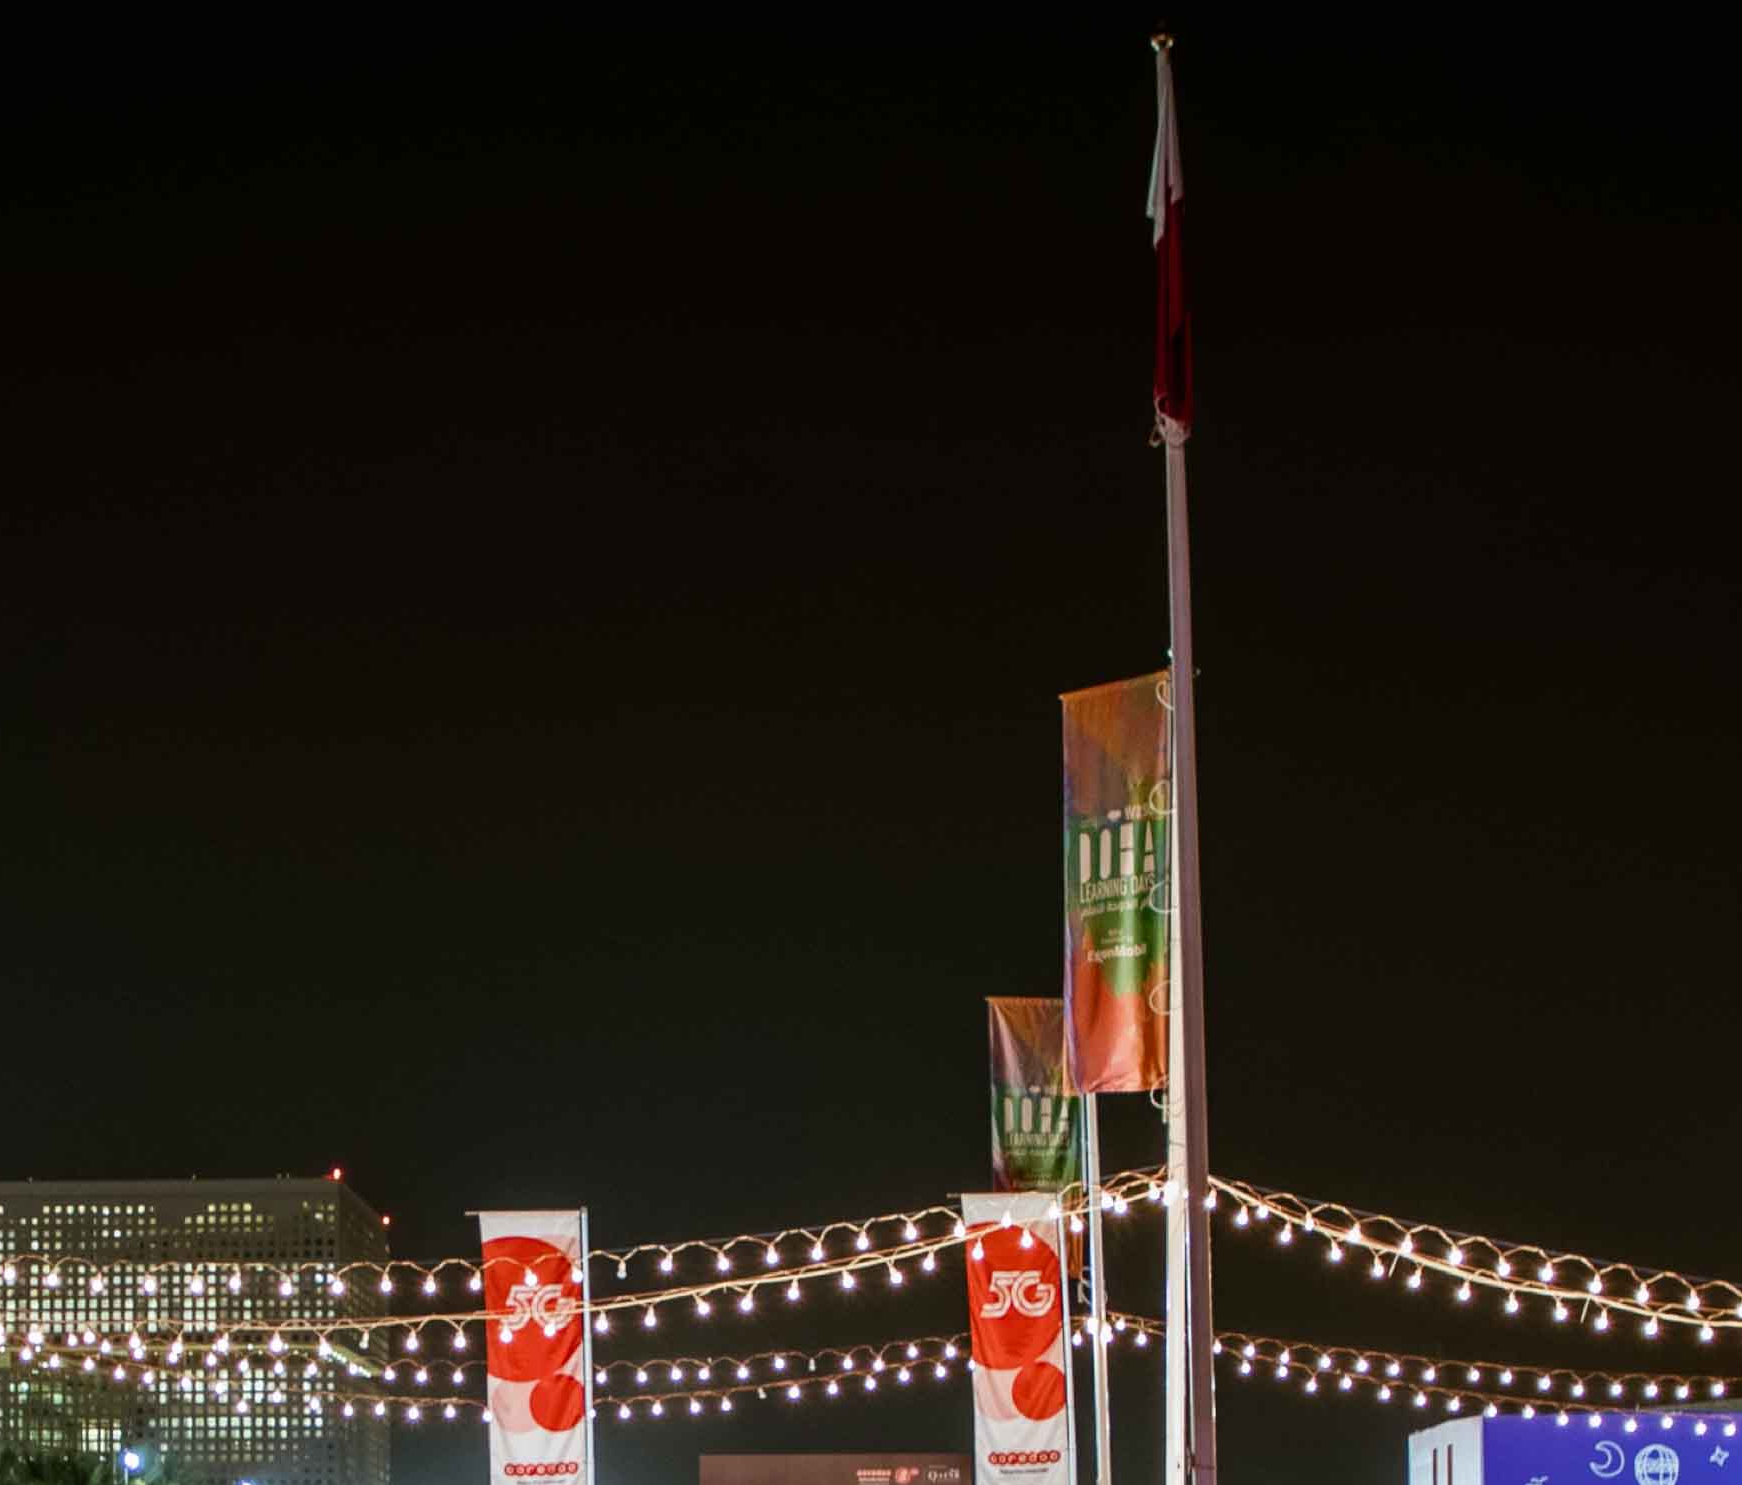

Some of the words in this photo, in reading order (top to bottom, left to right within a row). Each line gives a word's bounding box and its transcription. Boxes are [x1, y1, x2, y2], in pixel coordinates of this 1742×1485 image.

[1080, 878, 1127, 903] LEARNING
[499, 1284, 576, 1330] 5G
[980, 1270, 1056, 1319] 5G
[504, 1461, 578, 1476] ooredoo
[988, 1449, 1061, 1465] ooredoo
